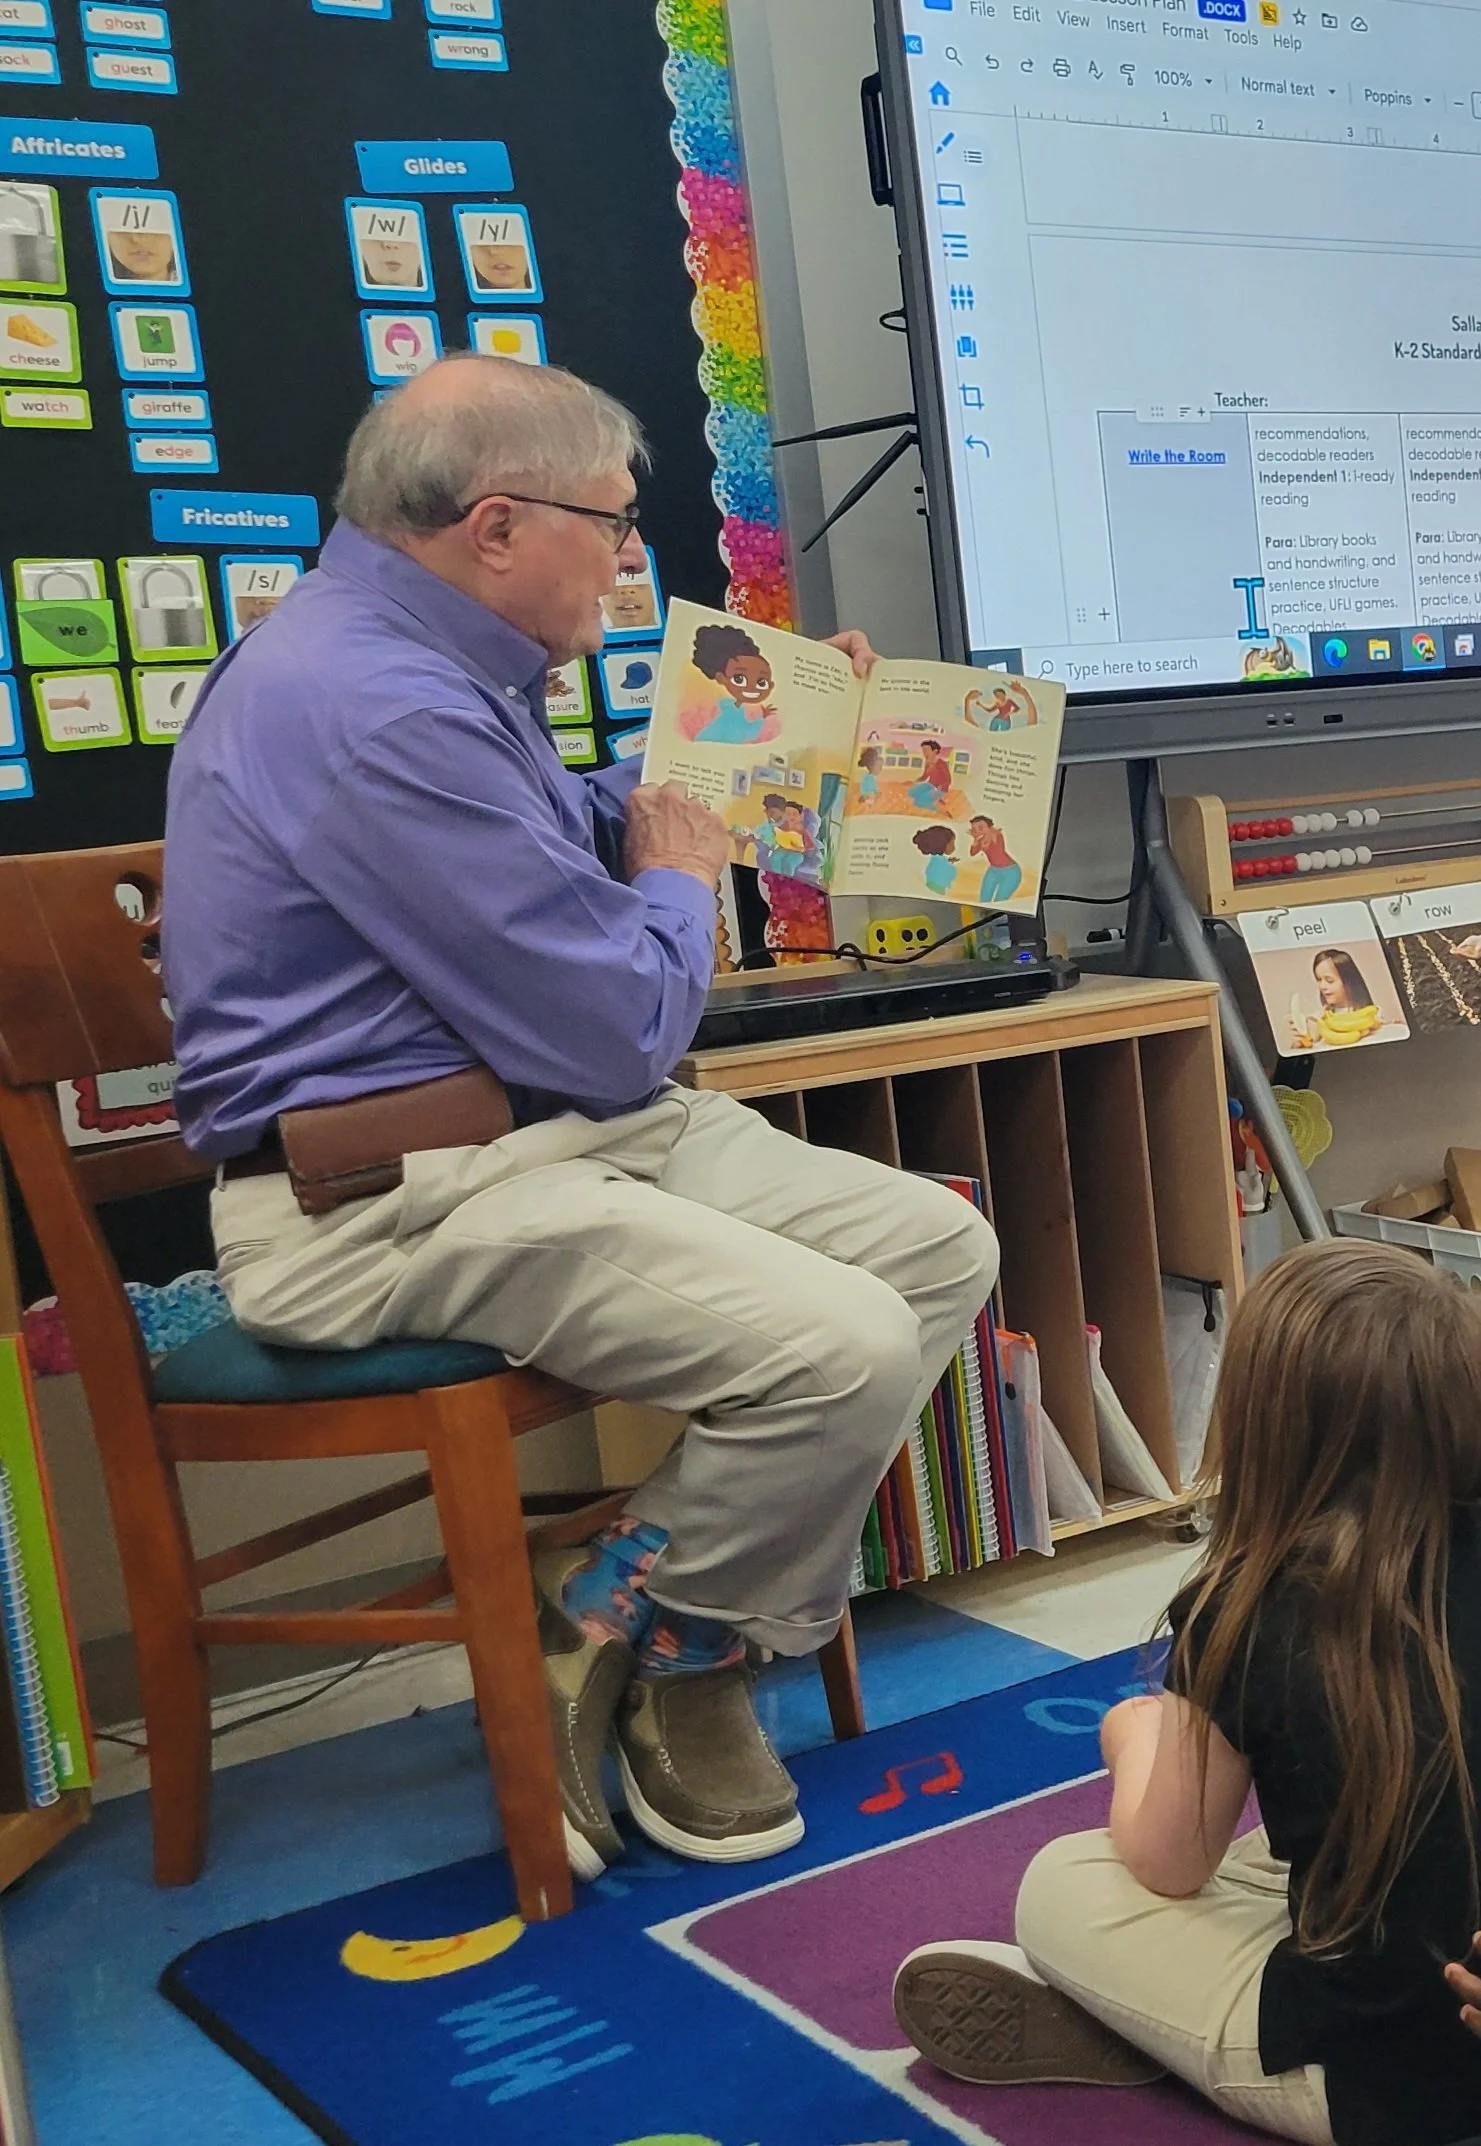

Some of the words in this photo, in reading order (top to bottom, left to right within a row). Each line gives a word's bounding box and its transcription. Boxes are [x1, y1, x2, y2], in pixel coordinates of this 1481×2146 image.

[1203, 2, 1242, 18] .DOCX
[104, 16, 147, 31] ghost
[970, 1, 996, 18] File
[1013, 6, 1041, 23] Edit
[1056, 10, 1090, 27] View
[1106, 16, 1147, 34] Insert
[1162, 22, 1209, 41] Format
[1224, 29, 1259, 46] Tools
[1273, 34, 1302, 52] Help
[447, 44, 489, 58] wrong
[111, 63, 153, 77] guest
[1154, 70, 1193, 87] 100%
[1241, 76, 1287, 95] Normal
[1290, 82, 1316, 97] text
[1364, 88, 1413, 107] Poppins
[11, 136, 127, 160] Affricates
[404, 158, 468, 175] Glides
[1394, 341, 1419, 359] K-2
[9, 352, 60, 367] cheese
[142, 355, 178, 370] jump
[395, 359, 418, 373] wig
[22, 400, 70, 414] watch
[142, 399, 192, 416] giraffe
[1214, 392, 1269, 408] Teacher:
[1255, 426, 1370, 441] recommendations,
[155, 444, 194, 460] edge
[1127, 449, 1163, 463] Write
[1165, 449, 1186, 463] the
[1189, 450, 1226, 463] Room
[1257, 448, 1327, 462] decodable
[1329, 448, 1375, 462] readers
[1408, 447, 1472, 461] decodable
[1258, 470, 1338, 486] Independent
[1353, 469, 1396, 485] i-ready
[1261, 493, 1310, 507] reading
[1411, 490, 1456, 505] reading
[182, 508, 290, 529] Fricatives
[1265, 535, 1297, 549] Para:
[1299, 535, 1339, 549] Library
[1341, 533, 1377, 547] books
[1415, 532, 1445, 544] Para:
[1267, 556, 1293, 570] and
[1295, 554, 1369, 571] handwriting,
[1372, 553, 1396, 567] and
[1417, 551, 1441, 565] and
[1268, 577, 1326, 592] sentence
[1329, 575, 1380, 589] structure
[1418, 571, 1471, 586] sentence
[1271, 598, 1327, 616] practice,
[1420, 592, 1472, 609] practice,
[58, 623, 88, 637] we
[1066, 661, 1099, 680] Type
[1103, 658, 1134, 675] here
[1137, 659, 1152, 674] to
[1155, 655, 1199, 672] search
[630, 695, 650, 705] hat
[63, 722, 110, 735] thumb
[155, 718, 187, 729] feat
[1424, 903, 1453, 920] row
[1293, 918, 1327, 941] peel
